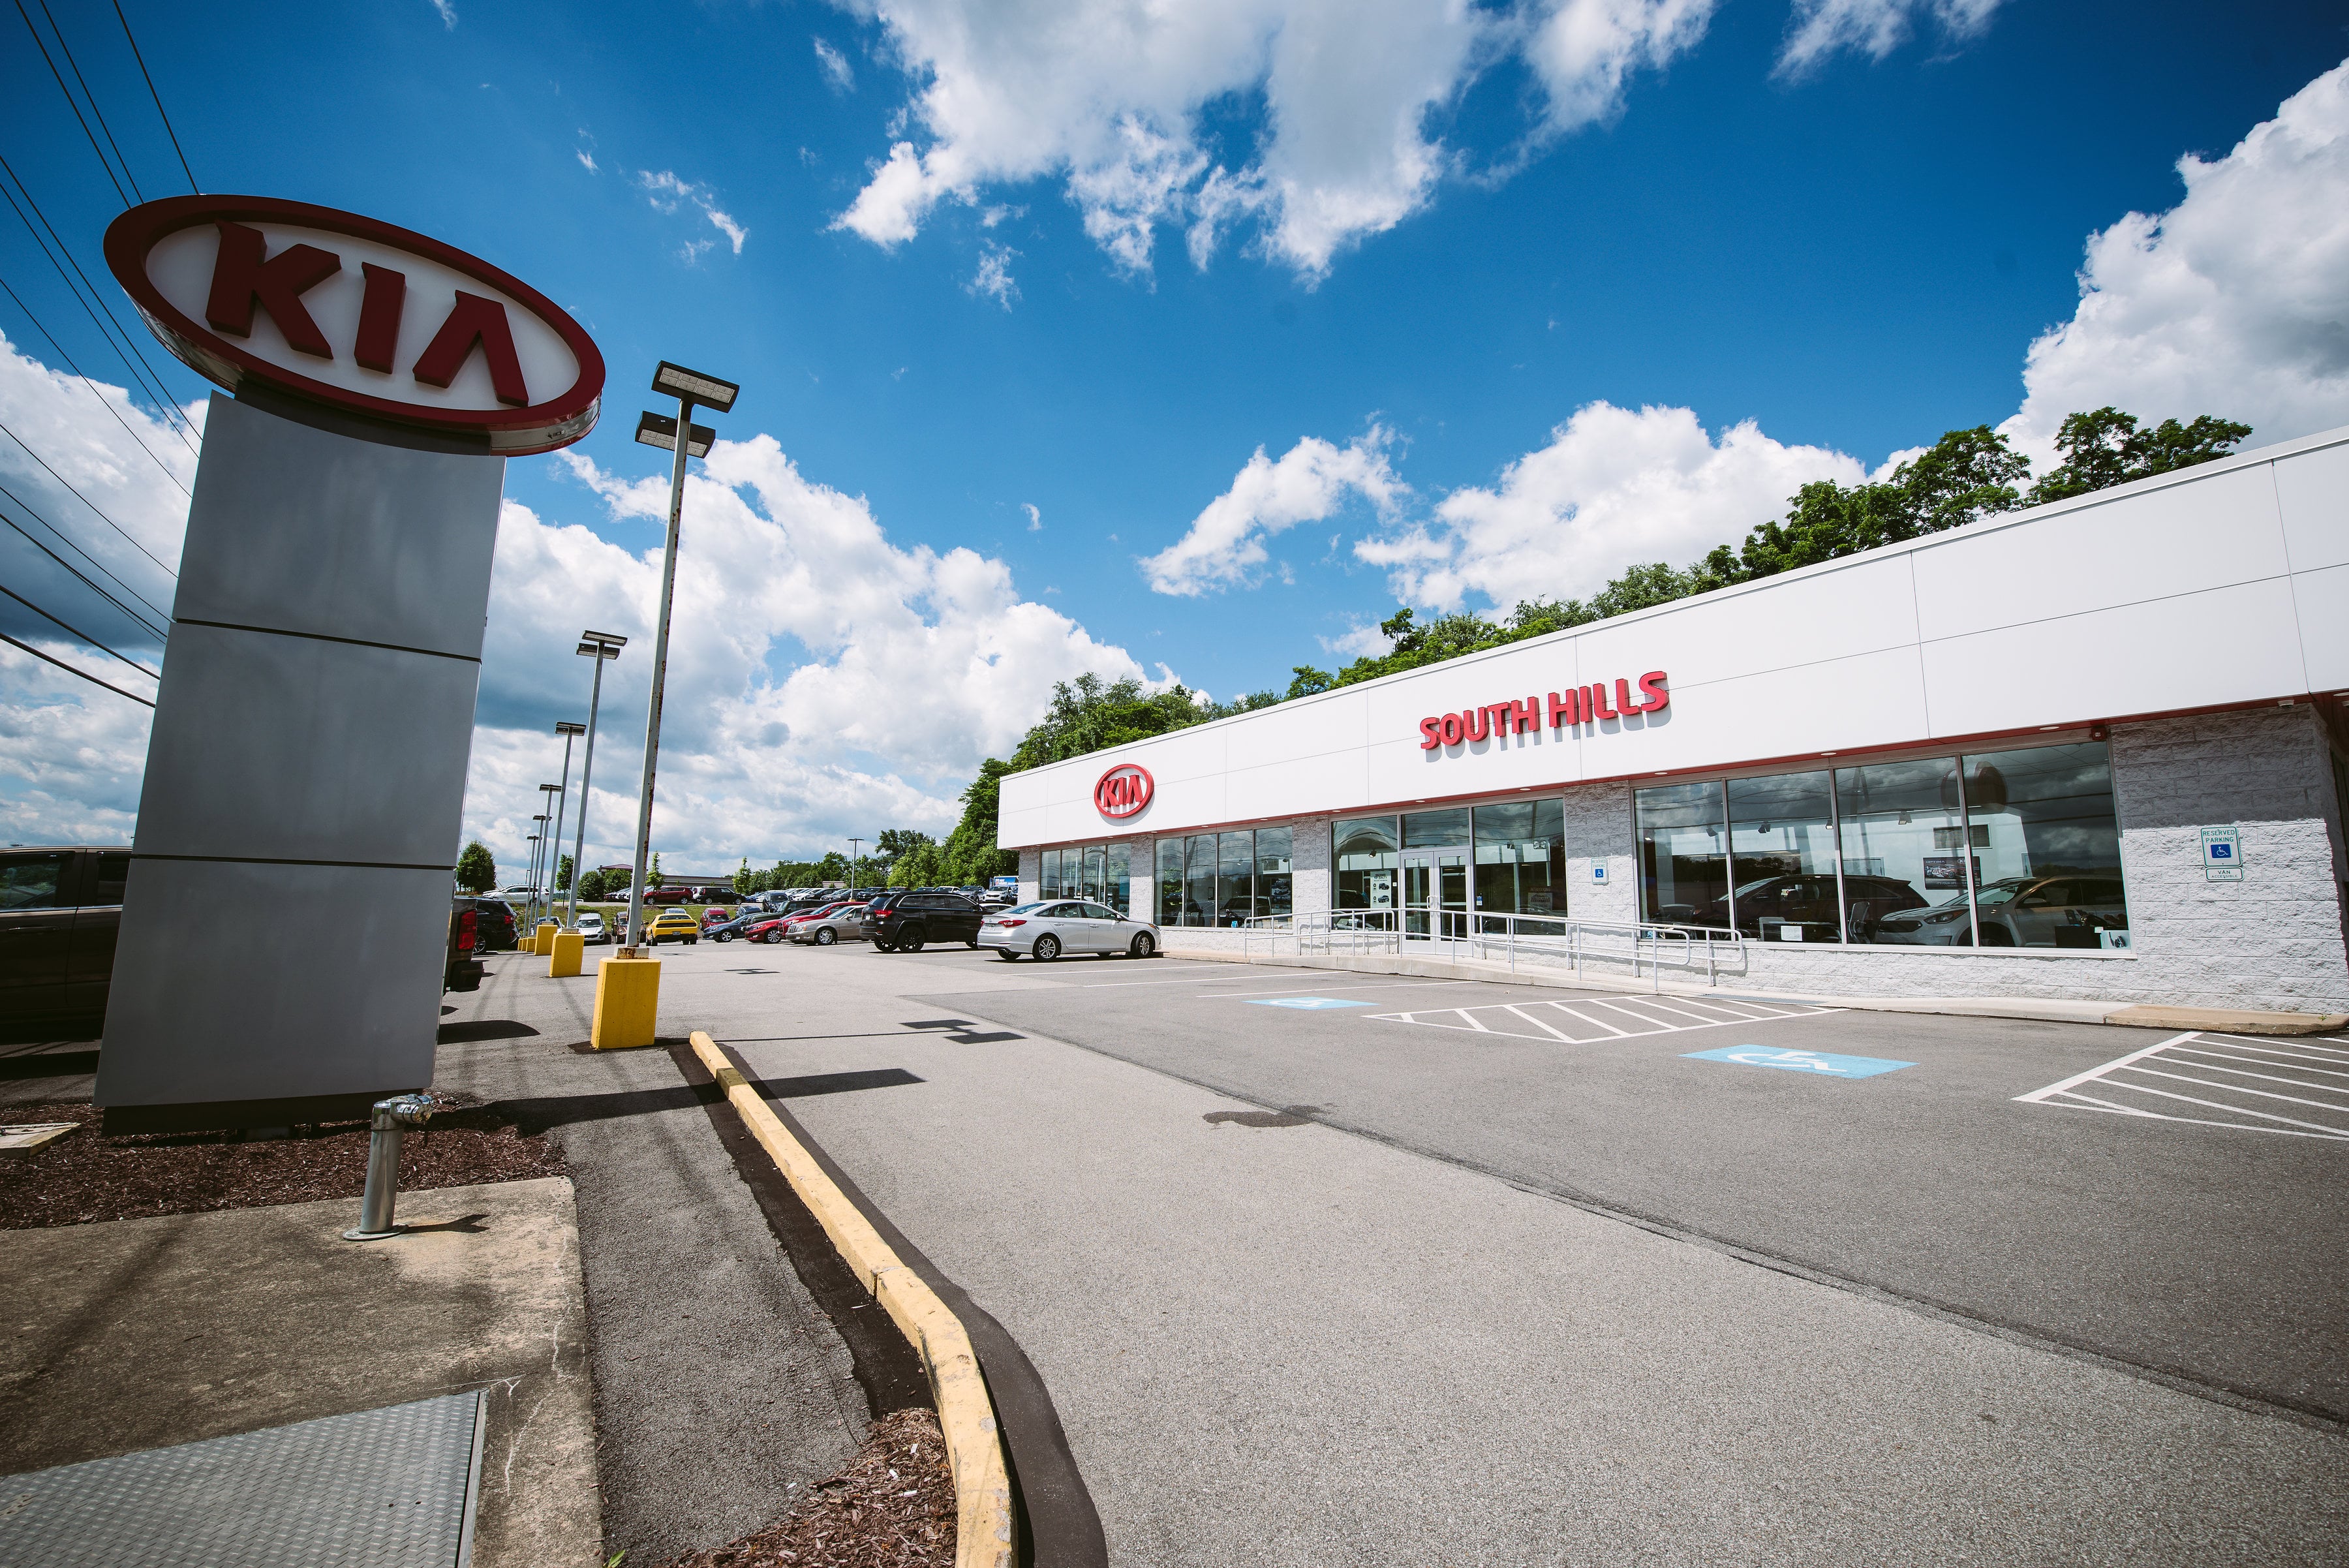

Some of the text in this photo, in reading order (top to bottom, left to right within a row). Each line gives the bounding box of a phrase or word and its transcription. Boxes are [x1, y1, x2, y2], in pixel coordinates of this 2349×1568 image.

[205, 219, 529, 408] KIA
[1420, 671, 1670, 750] SOUTH HILLS
[1103, 775, 1144, 807] KIA
